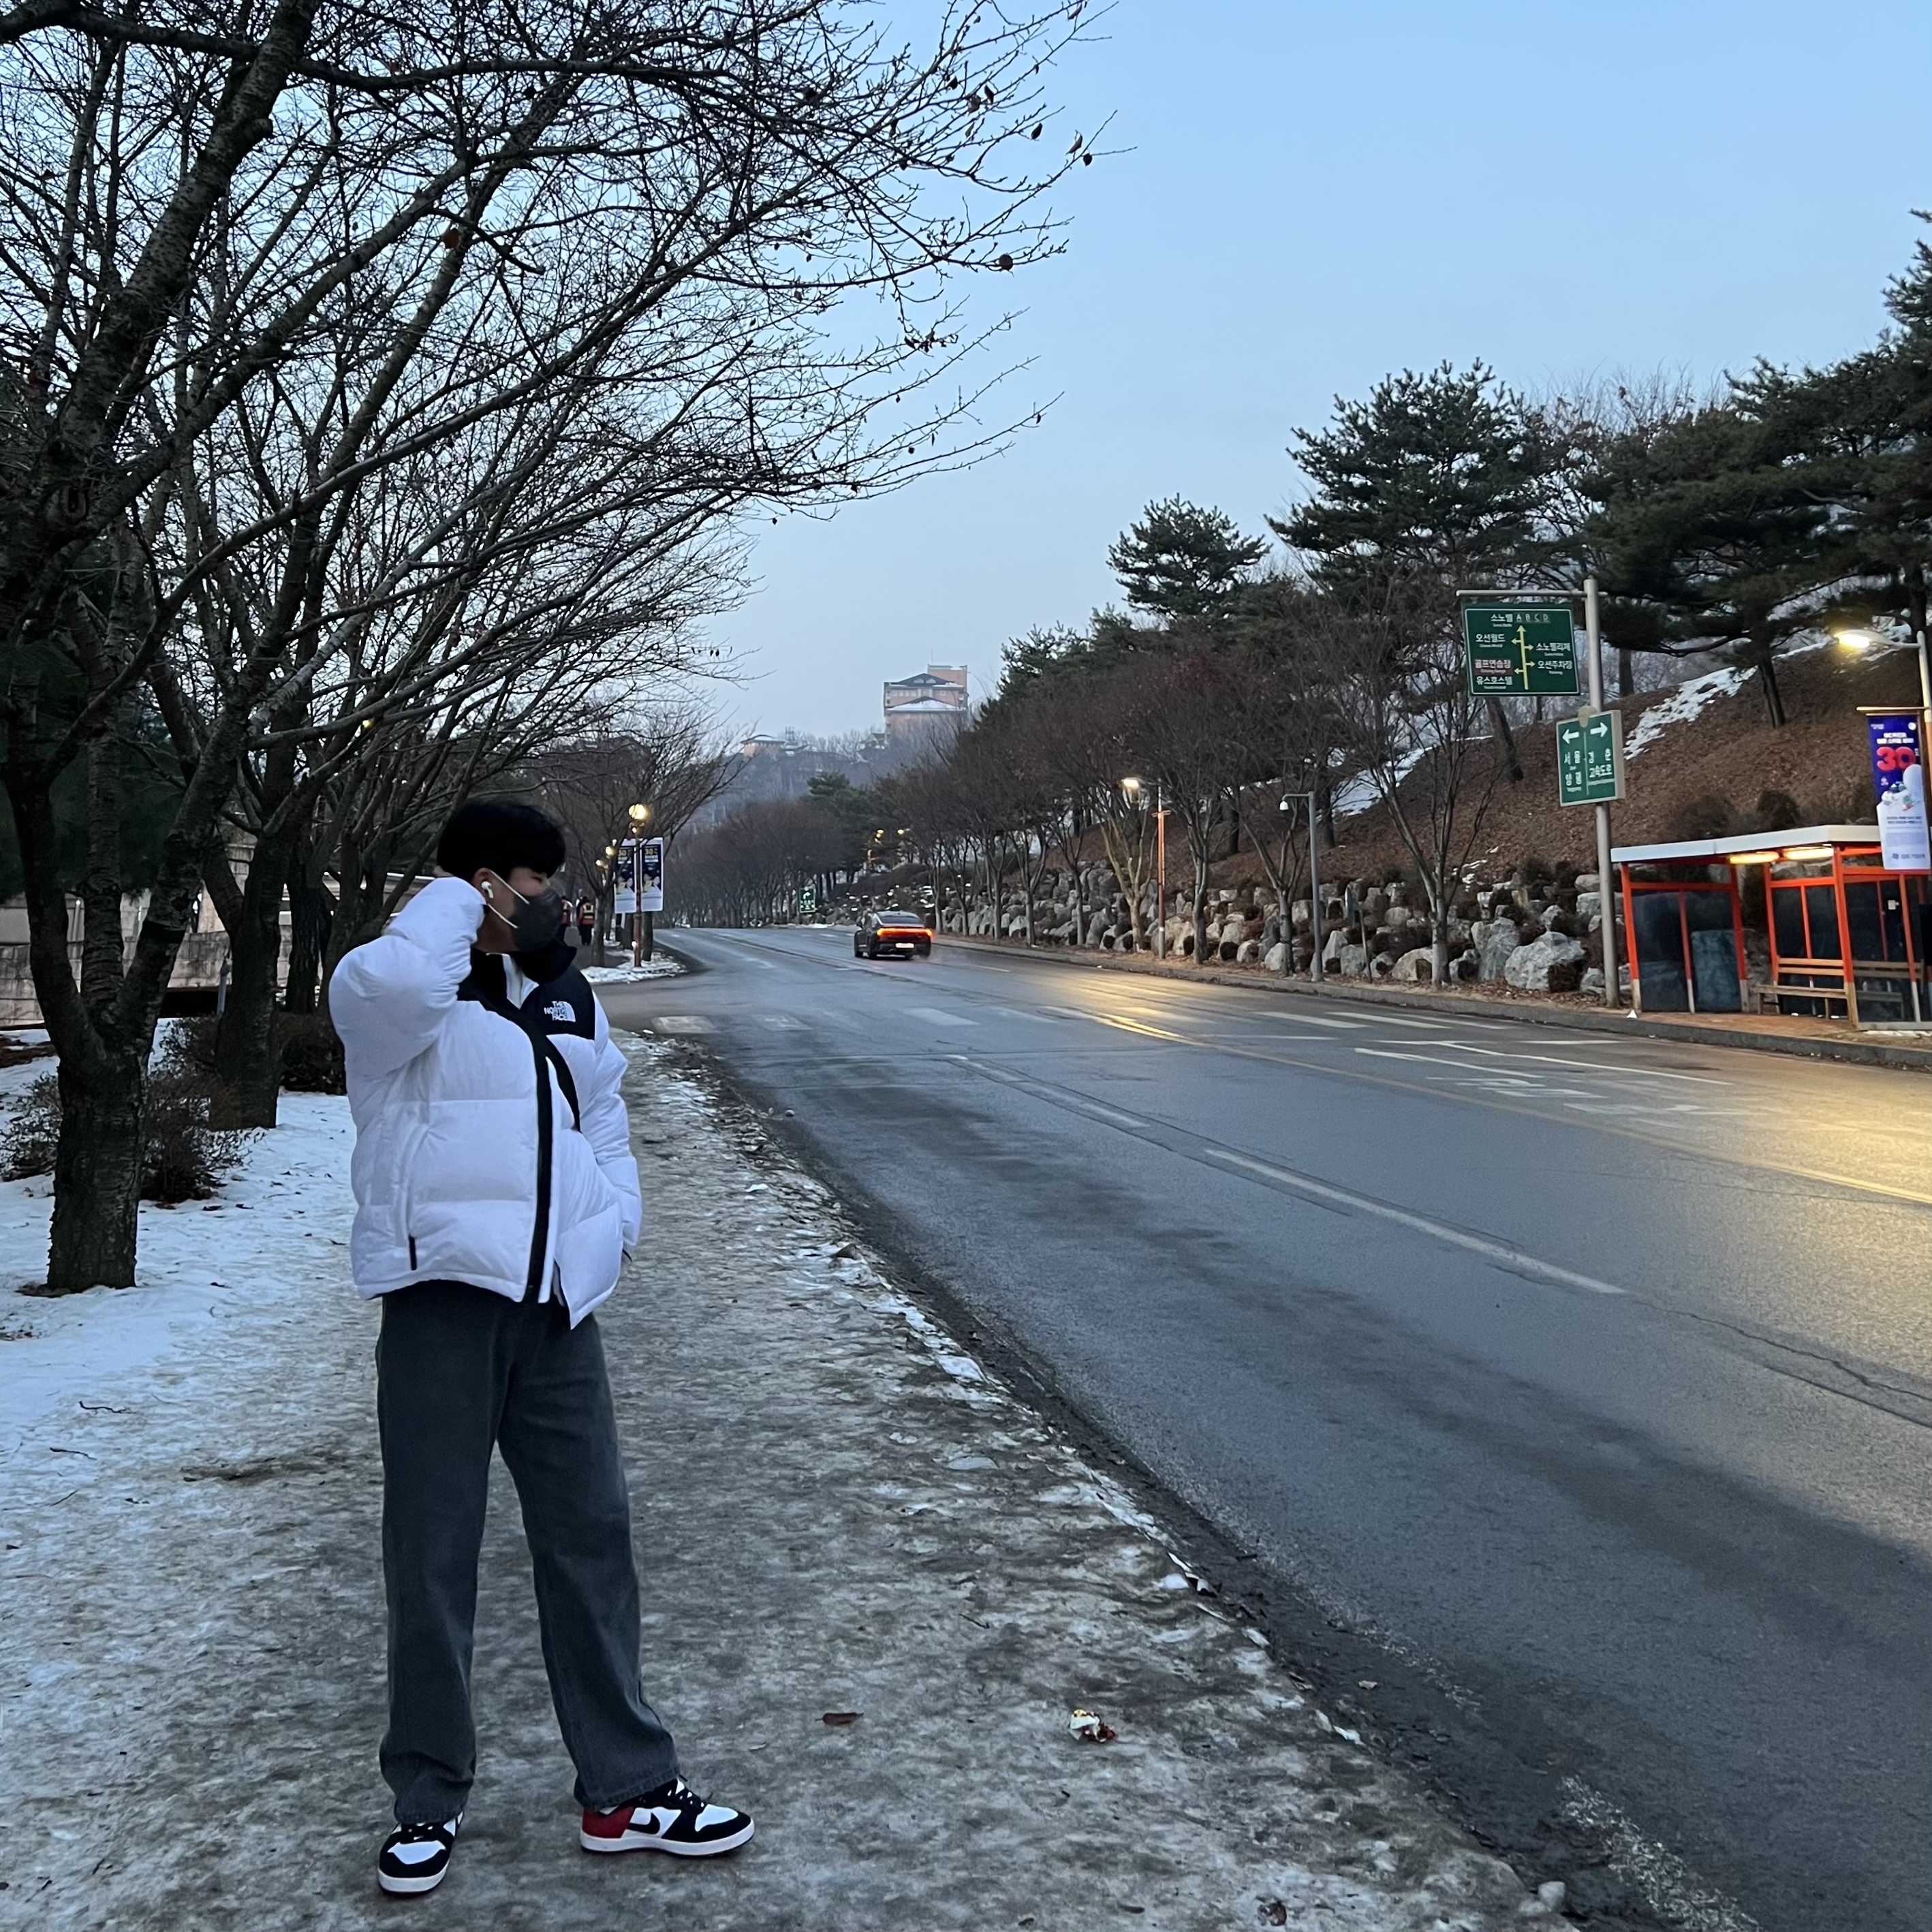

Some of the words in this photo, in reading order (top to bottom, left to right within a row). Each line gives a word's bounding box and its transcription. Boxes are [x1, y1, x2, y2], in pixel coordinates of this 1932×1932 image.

[1476, 634, 1506, 642] 오션월드
[1475, 659, 1511, 668] 골프연습장
[1538, 660, 1573, 669] 오션주차장
[1476, 676, 1512, 685] 유스호스텔
[1589, 764, 1612, 778] 고속도로
